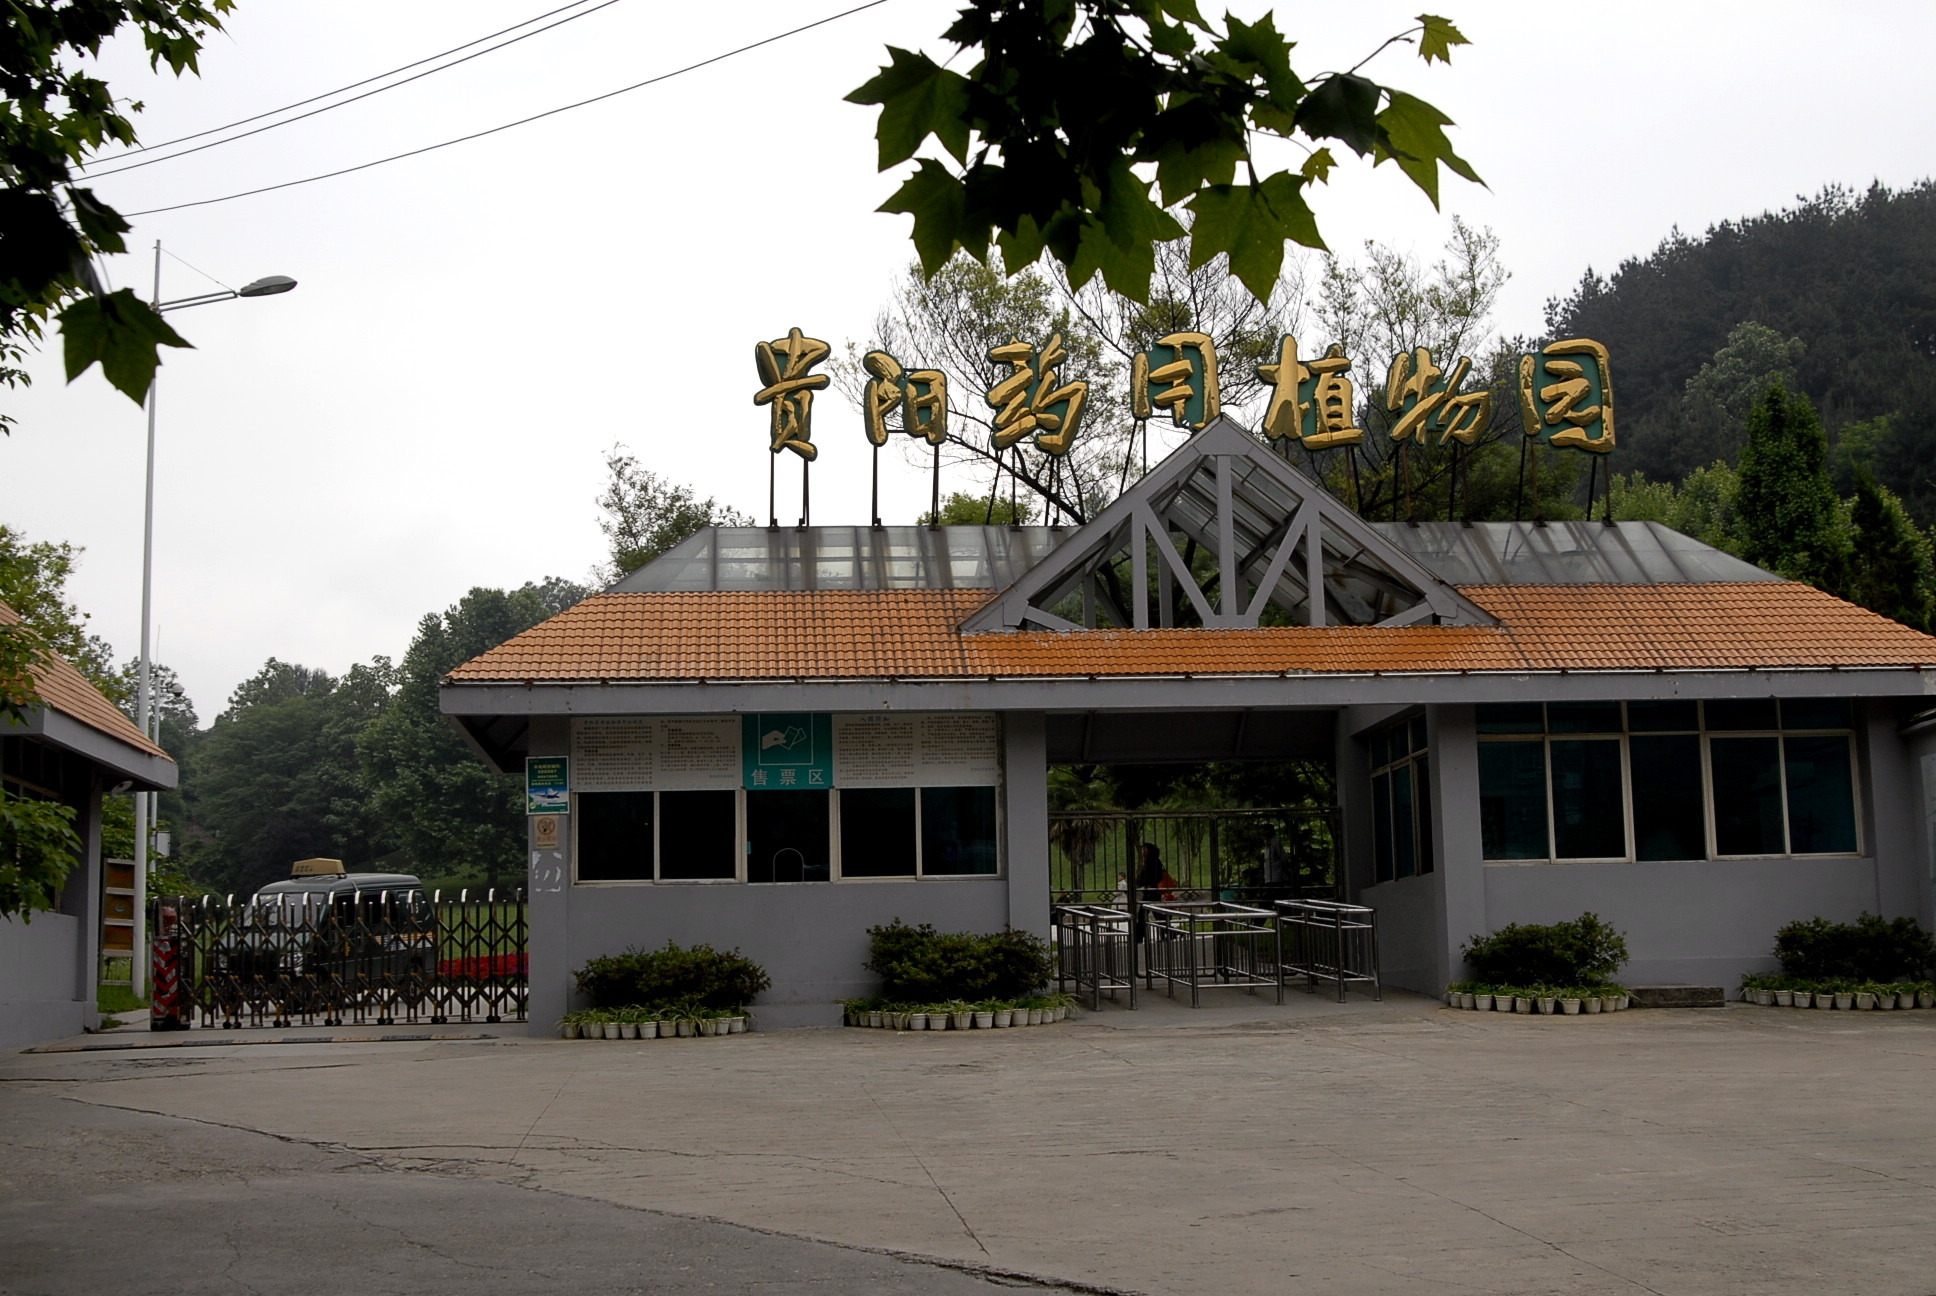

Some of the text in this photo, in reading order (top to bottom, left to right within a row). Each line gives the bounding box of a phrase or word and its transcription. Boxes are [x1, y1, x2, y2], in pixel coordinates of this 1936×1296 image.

[755, 327, 1616, 461] 贵阳药用植物园
[751, 768, 825, 786] 售票区
